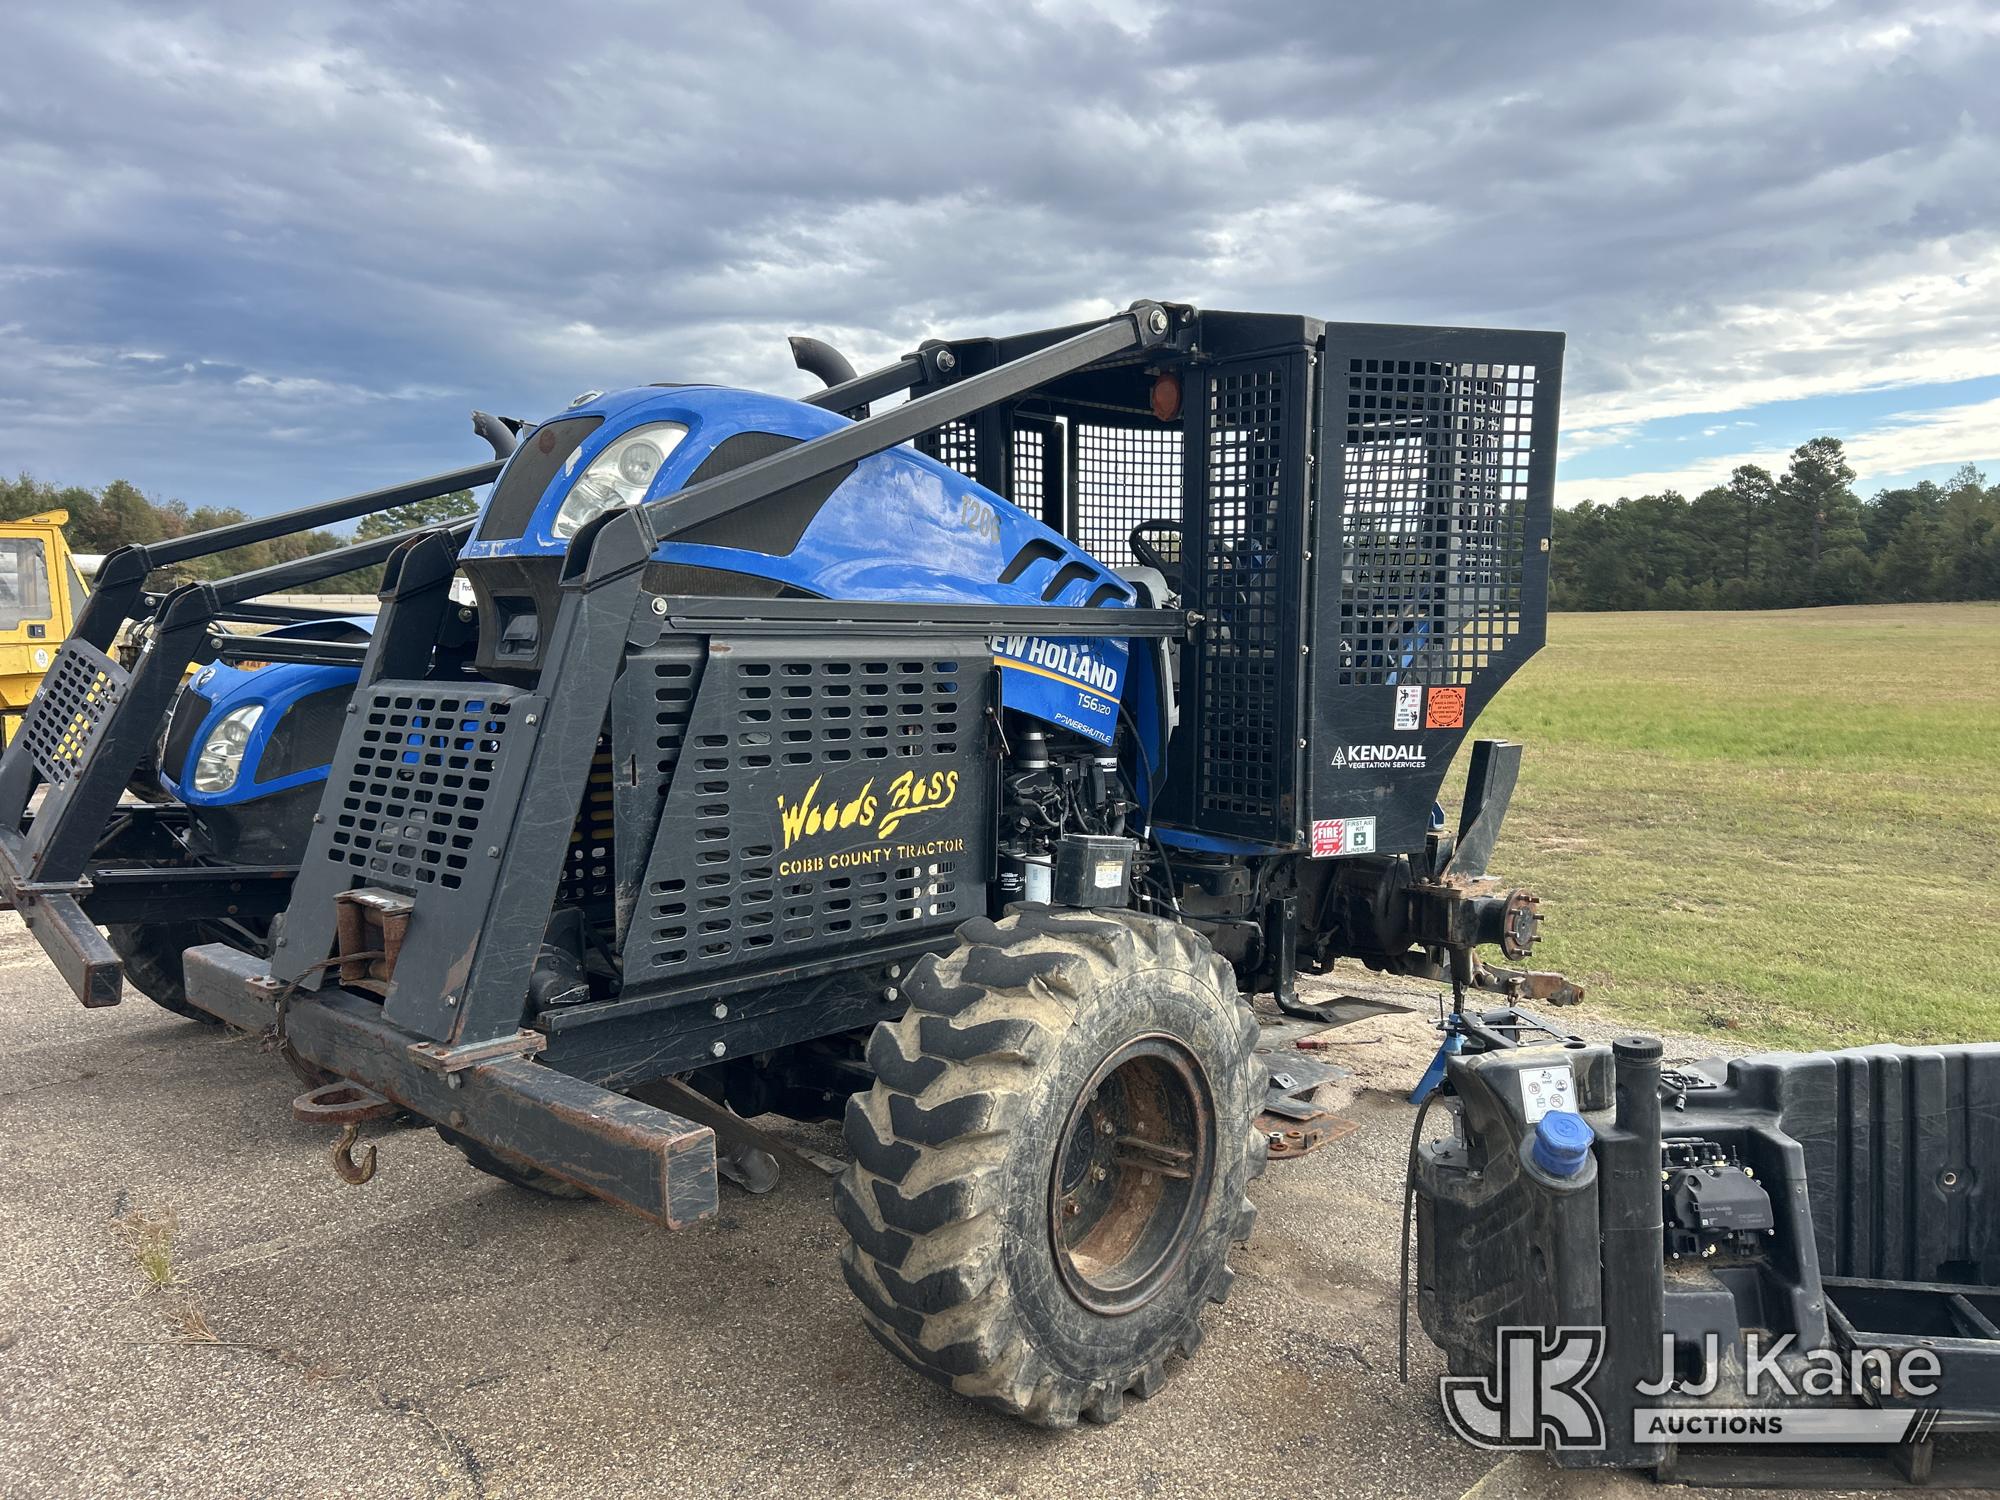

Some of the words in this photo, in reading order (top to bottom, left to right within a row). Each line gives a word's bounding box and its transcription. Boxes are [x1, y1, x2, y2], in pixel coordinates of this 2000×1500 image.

[988, 636, 1028, 658] EW
[1028, 637, 1118, 693] HOLLAND
[1055, 712, 1112, 743] POWERSHUTTLE
[1348, 744, 1427, 761] KENDALL
[1348, 761, 1391, 769] VEGETATION
[1392, 761, 1426, 769] SERVICES
[777, 772, 879, 850] Woods
[880, 770, 959, 830] Boss
[1318, 826, 1339, 840] FIRE
[780, 857, 824, 876] COBB
[829, 847, 893, 867] COUNTY
[897, 838, 965, 860] TRACTOR
